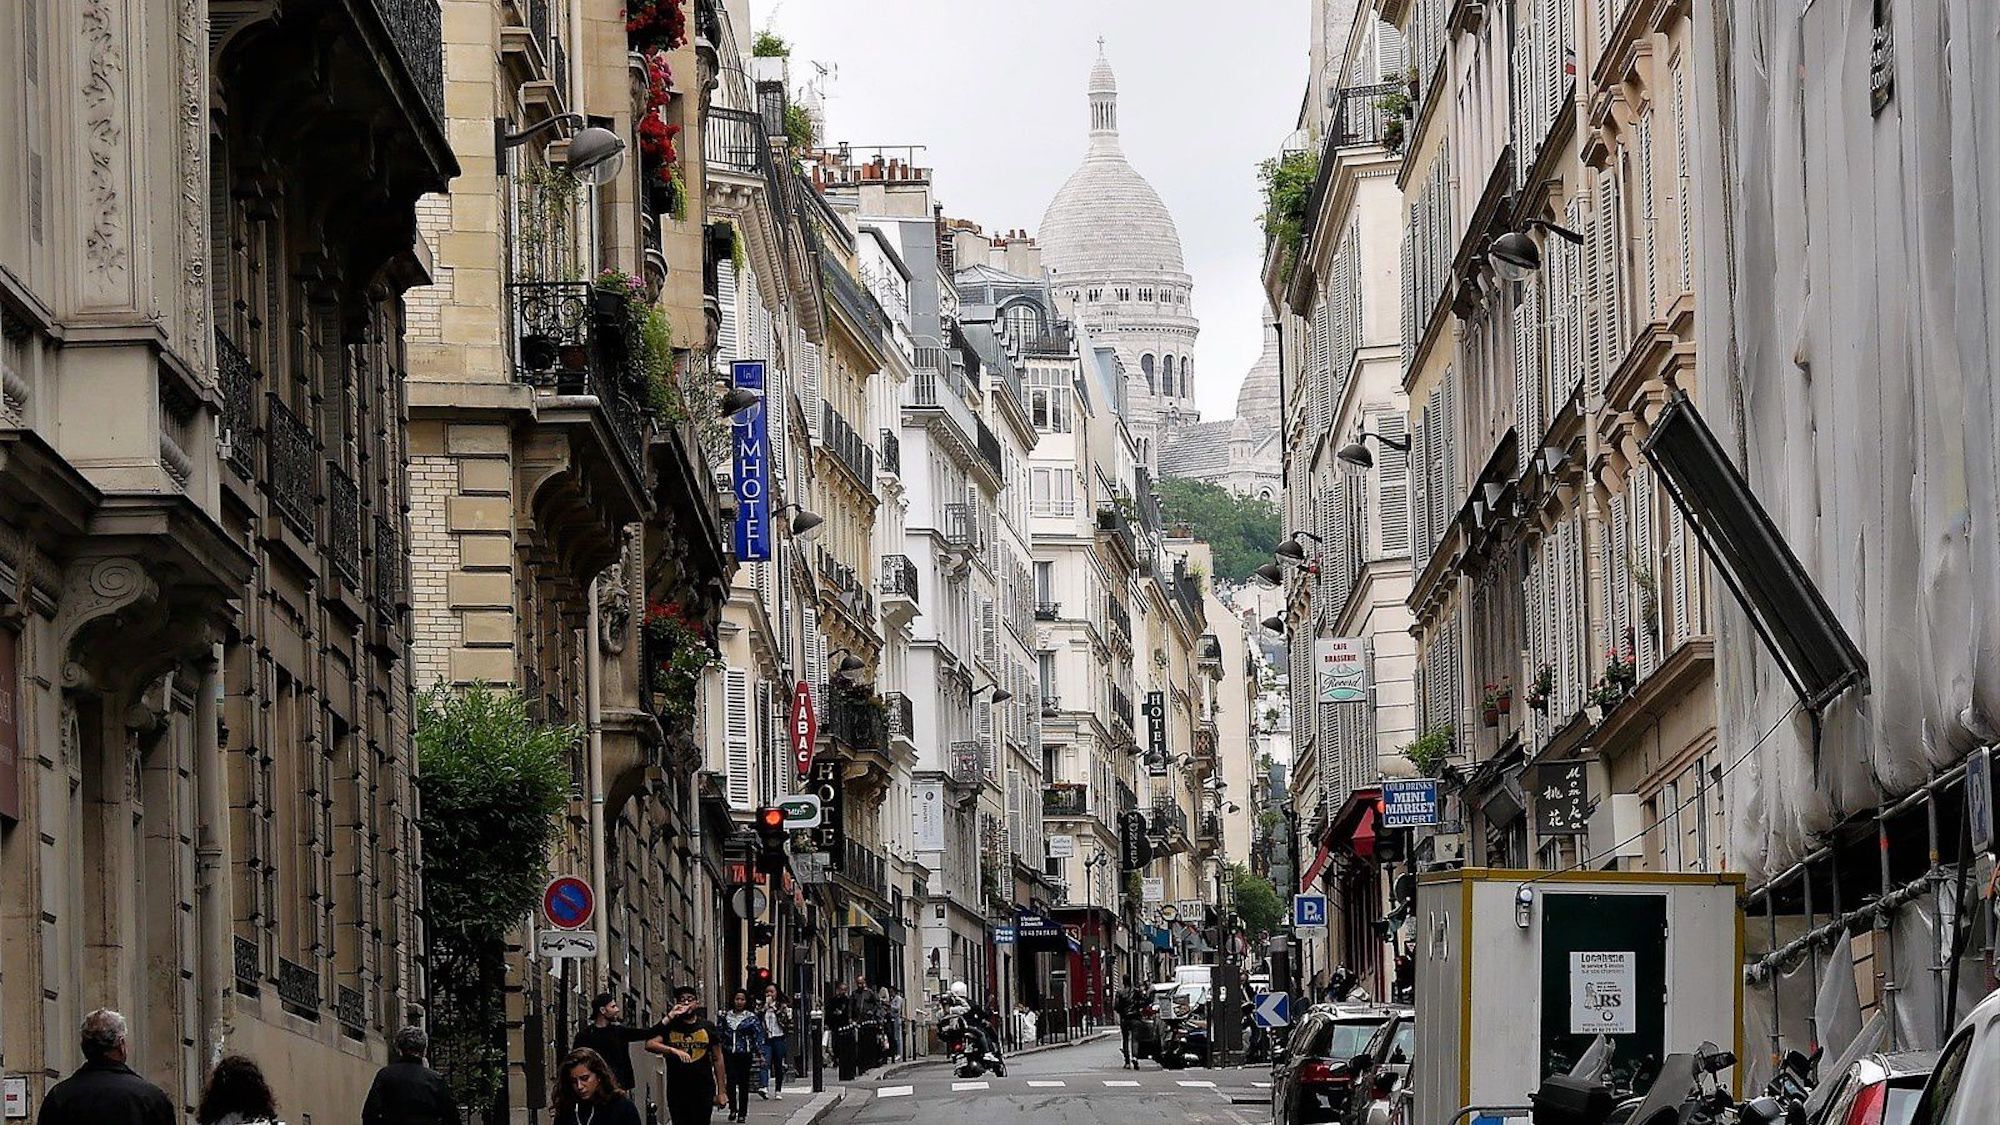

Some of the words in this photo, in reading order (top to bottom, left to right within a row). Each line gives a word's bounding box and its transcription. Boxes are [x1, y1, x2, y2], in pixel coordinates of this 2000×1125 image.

[798, 693, 808, 761] TABAC
[1385, 782, 1405, 791] COLD
[1406, 781, 1433, 790] DRINKS
[1393, 792, 1425, 803] MINI
[1386, 803, 1434, 815] MARKET
[1387, 814, 1433, 824] OUVERT
[1183, 904, 1201, 917] BAR
